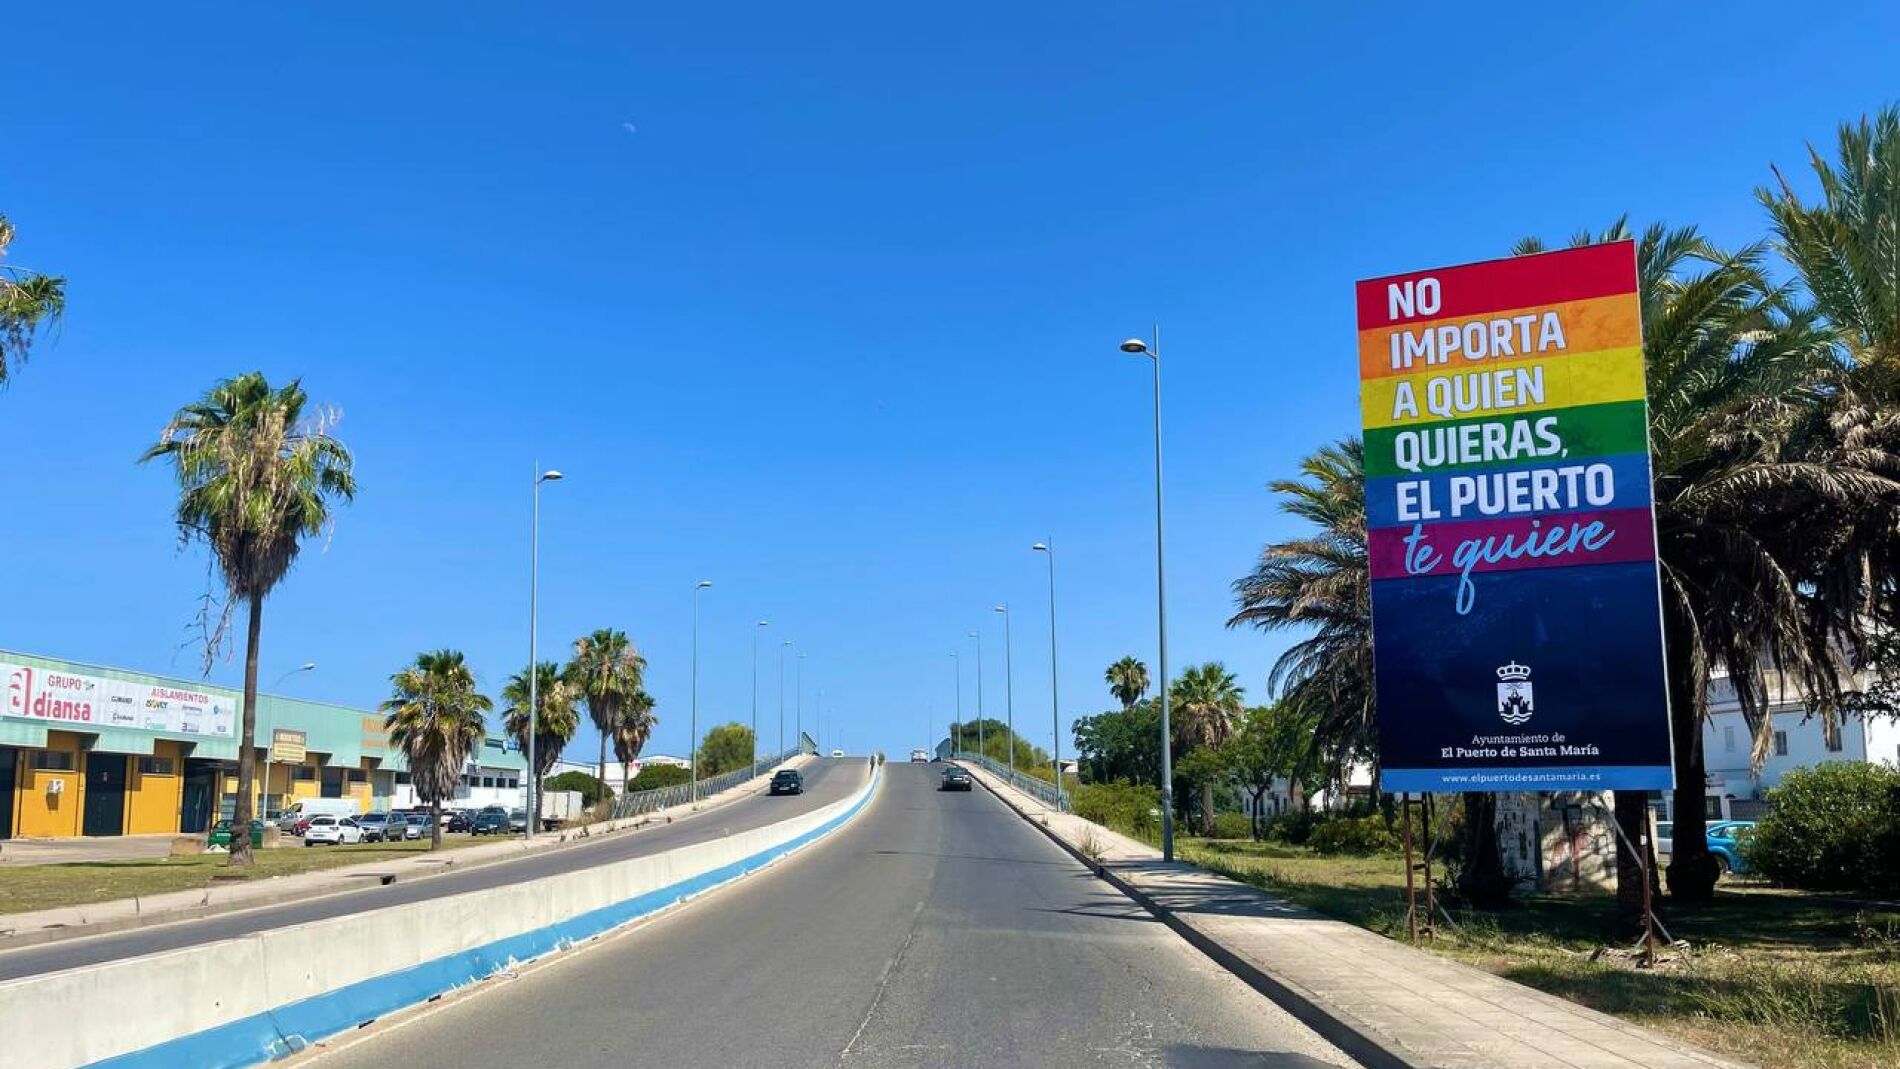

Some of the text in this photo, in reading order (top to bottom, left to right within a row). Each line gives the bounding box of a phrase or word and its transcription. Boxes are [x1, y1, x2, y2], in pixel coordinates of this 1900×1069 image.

[1388, 278, 1441, 320] NO
[1391, 312, 1567, 369] IMPORTA
[1392, 366, 1545, 420] A QUIEN
[1394, 416, 1569, 473] QUIERAS,
[1396, 463, 1615, 522] EL PUERTO
[1402, 520, 1616, 616] te quiere
[48, 675, 82, 691] GRUPO
[151, 687, 209, 705] AISLAMIENTOS
[34, 692, 92, 721] diansa
[1441, 744, 1600, 758] El Puerto de Santa María
[1472, 732, 1566, 746] Ayuntamiento de
[1443, 773, 1601, 783] www.elpuertodesantamaria.es
